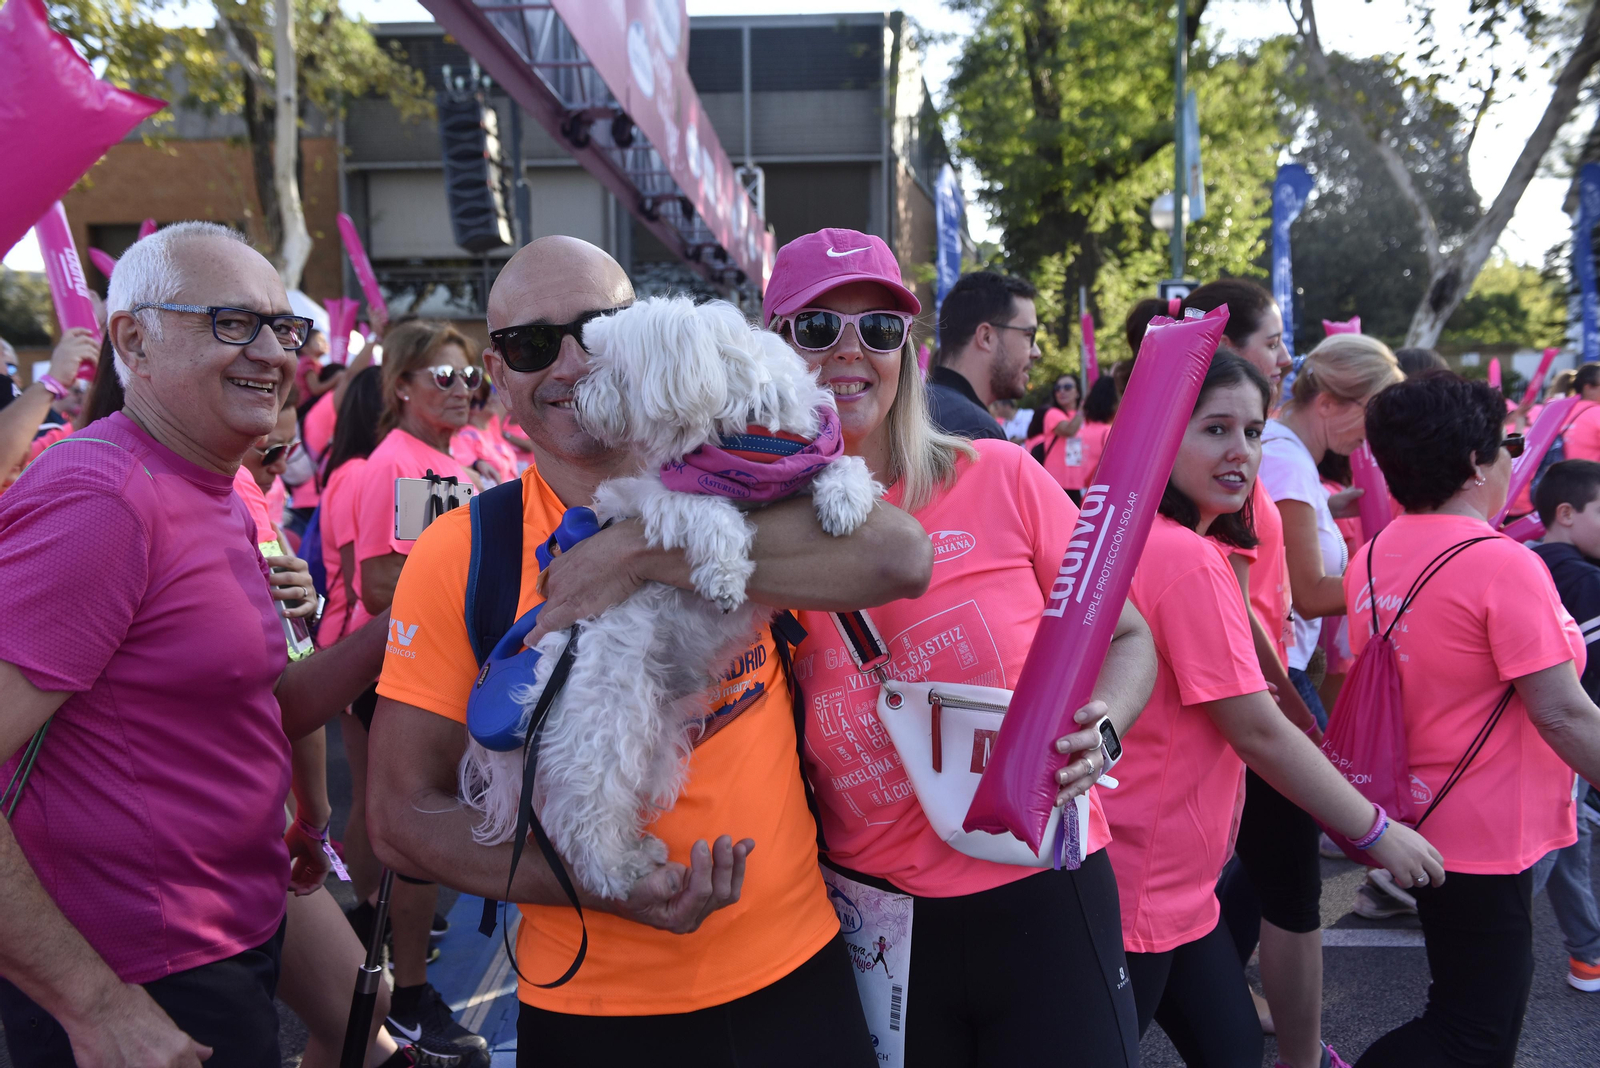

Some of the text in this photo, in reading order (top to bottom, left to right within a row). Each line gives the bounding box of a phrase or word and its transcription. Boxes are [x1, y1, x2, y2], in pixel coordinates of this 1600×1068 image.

[1083, 491, 1138, 626] TRIPLE PROTECCIÓN SOLAR
[831, 757, 894, 791] BARCELONA
[893, 781, 914, 799] COR
